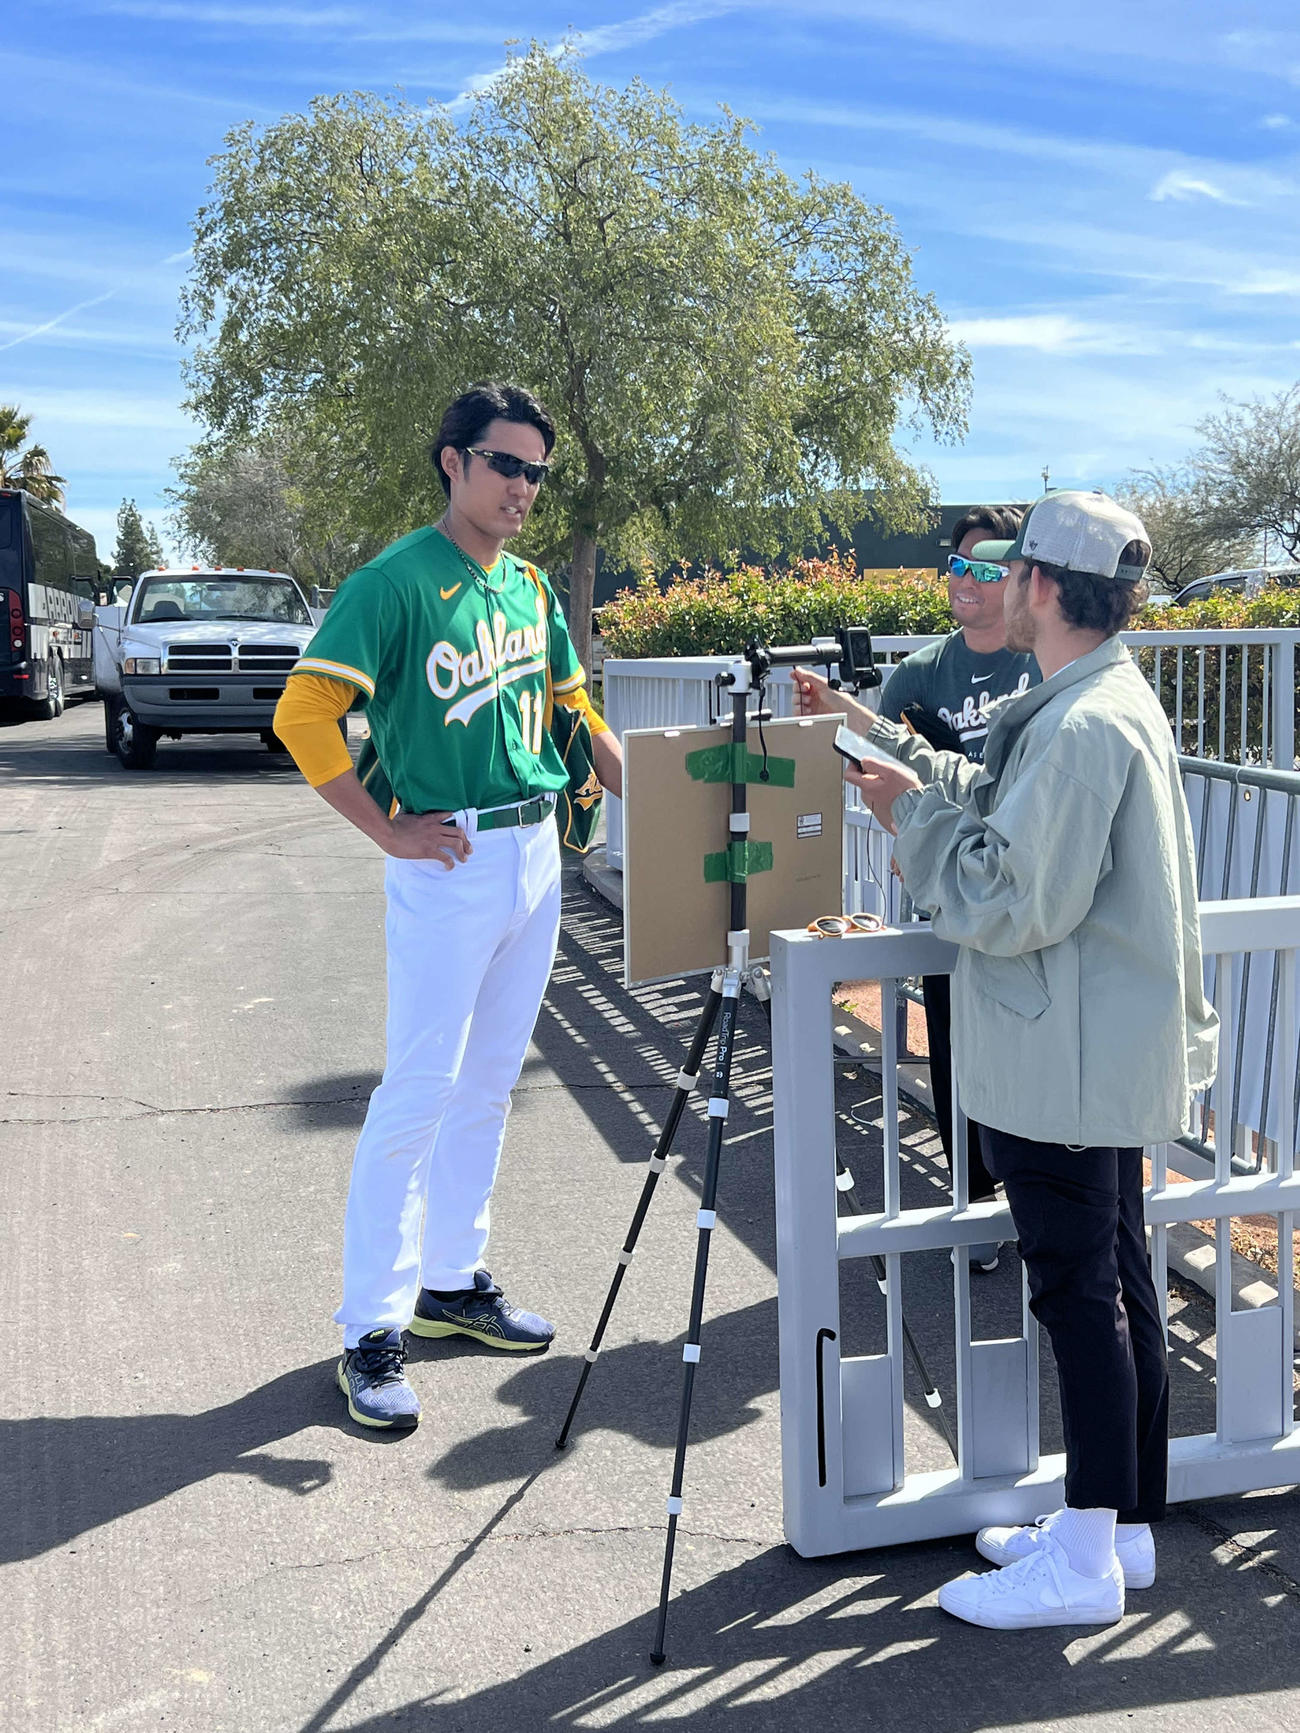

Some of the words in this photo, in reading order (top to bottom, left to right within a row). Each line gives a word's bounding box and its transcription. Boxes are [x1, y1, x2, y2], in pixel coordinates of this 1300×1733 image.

[425, 594, 547, 700] Oakland
[519, 690, 544, 755] 11
[938, 672, 1030, 731] akld
[718, 1046, 728, 1062] Pro
